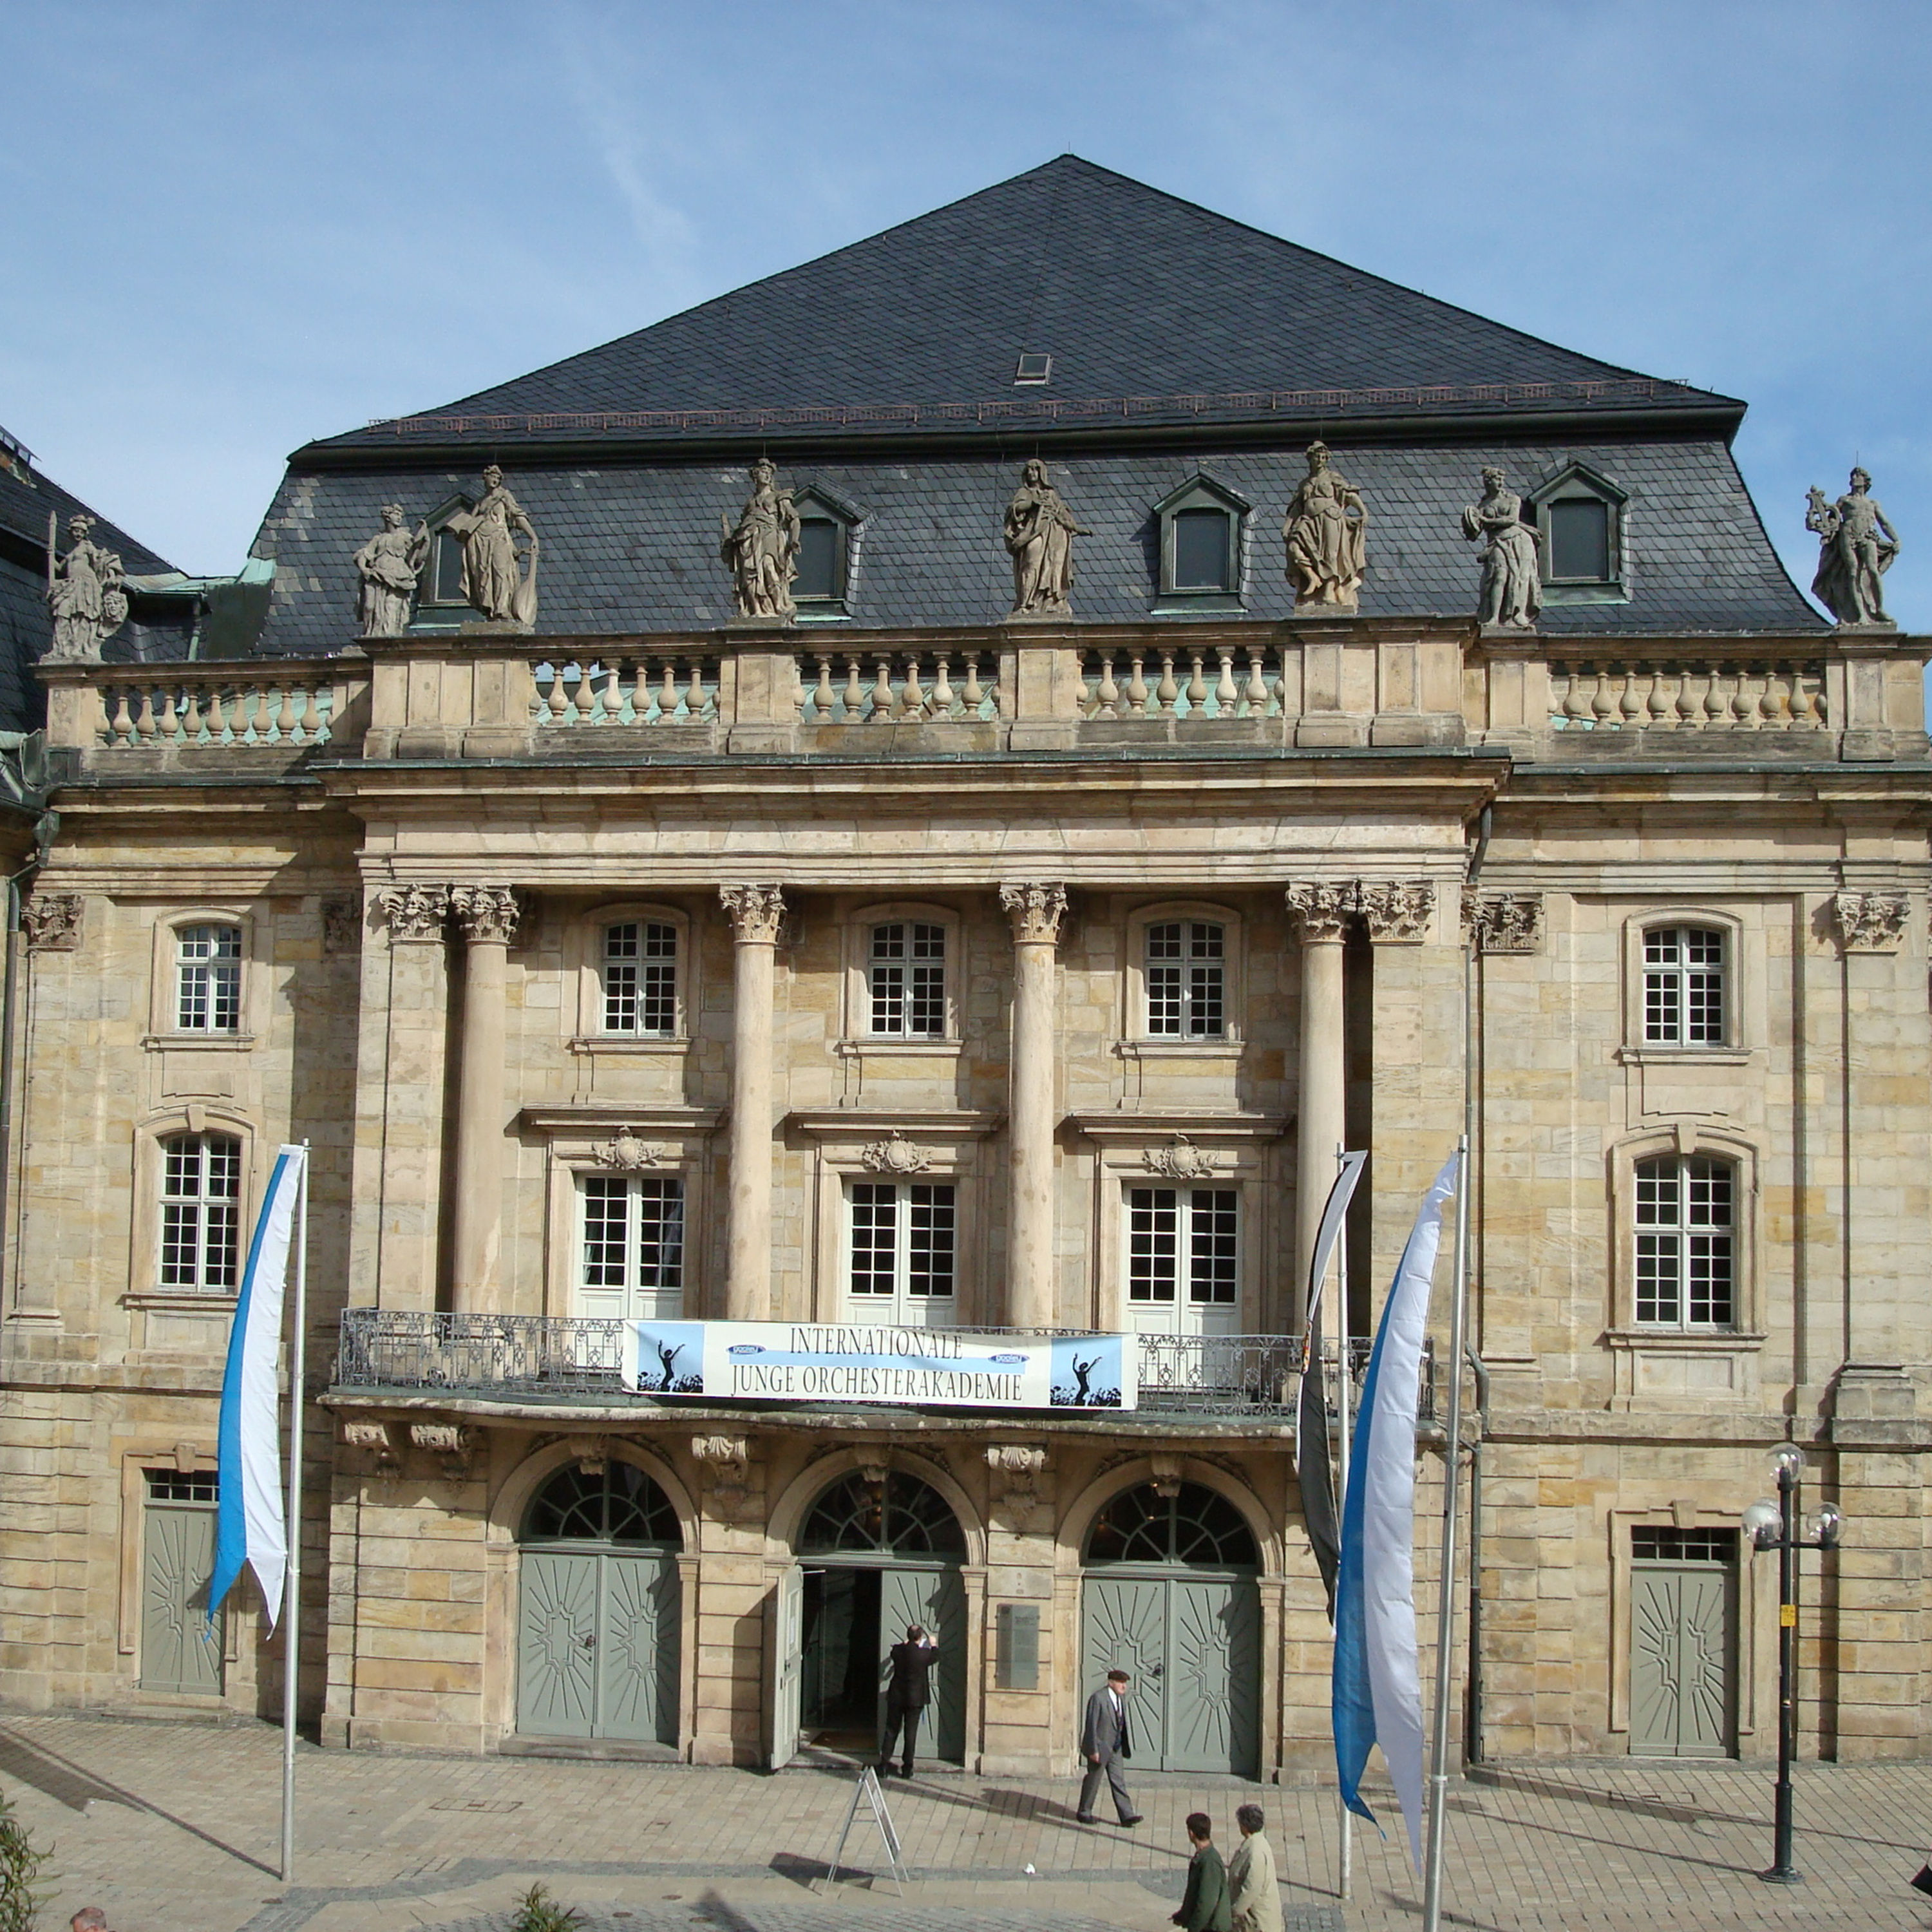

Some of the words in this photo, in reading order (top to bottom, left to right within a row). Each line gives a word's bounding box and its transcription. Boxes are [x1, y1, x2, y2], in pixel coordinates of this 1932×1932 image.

[790, 1327, 963, 1359] INTERNATIONALE
[730, 1365, 795, 1397] JUNGE
[802, 1366, 1023, 1401] ORCHESTERAKADEMIE
